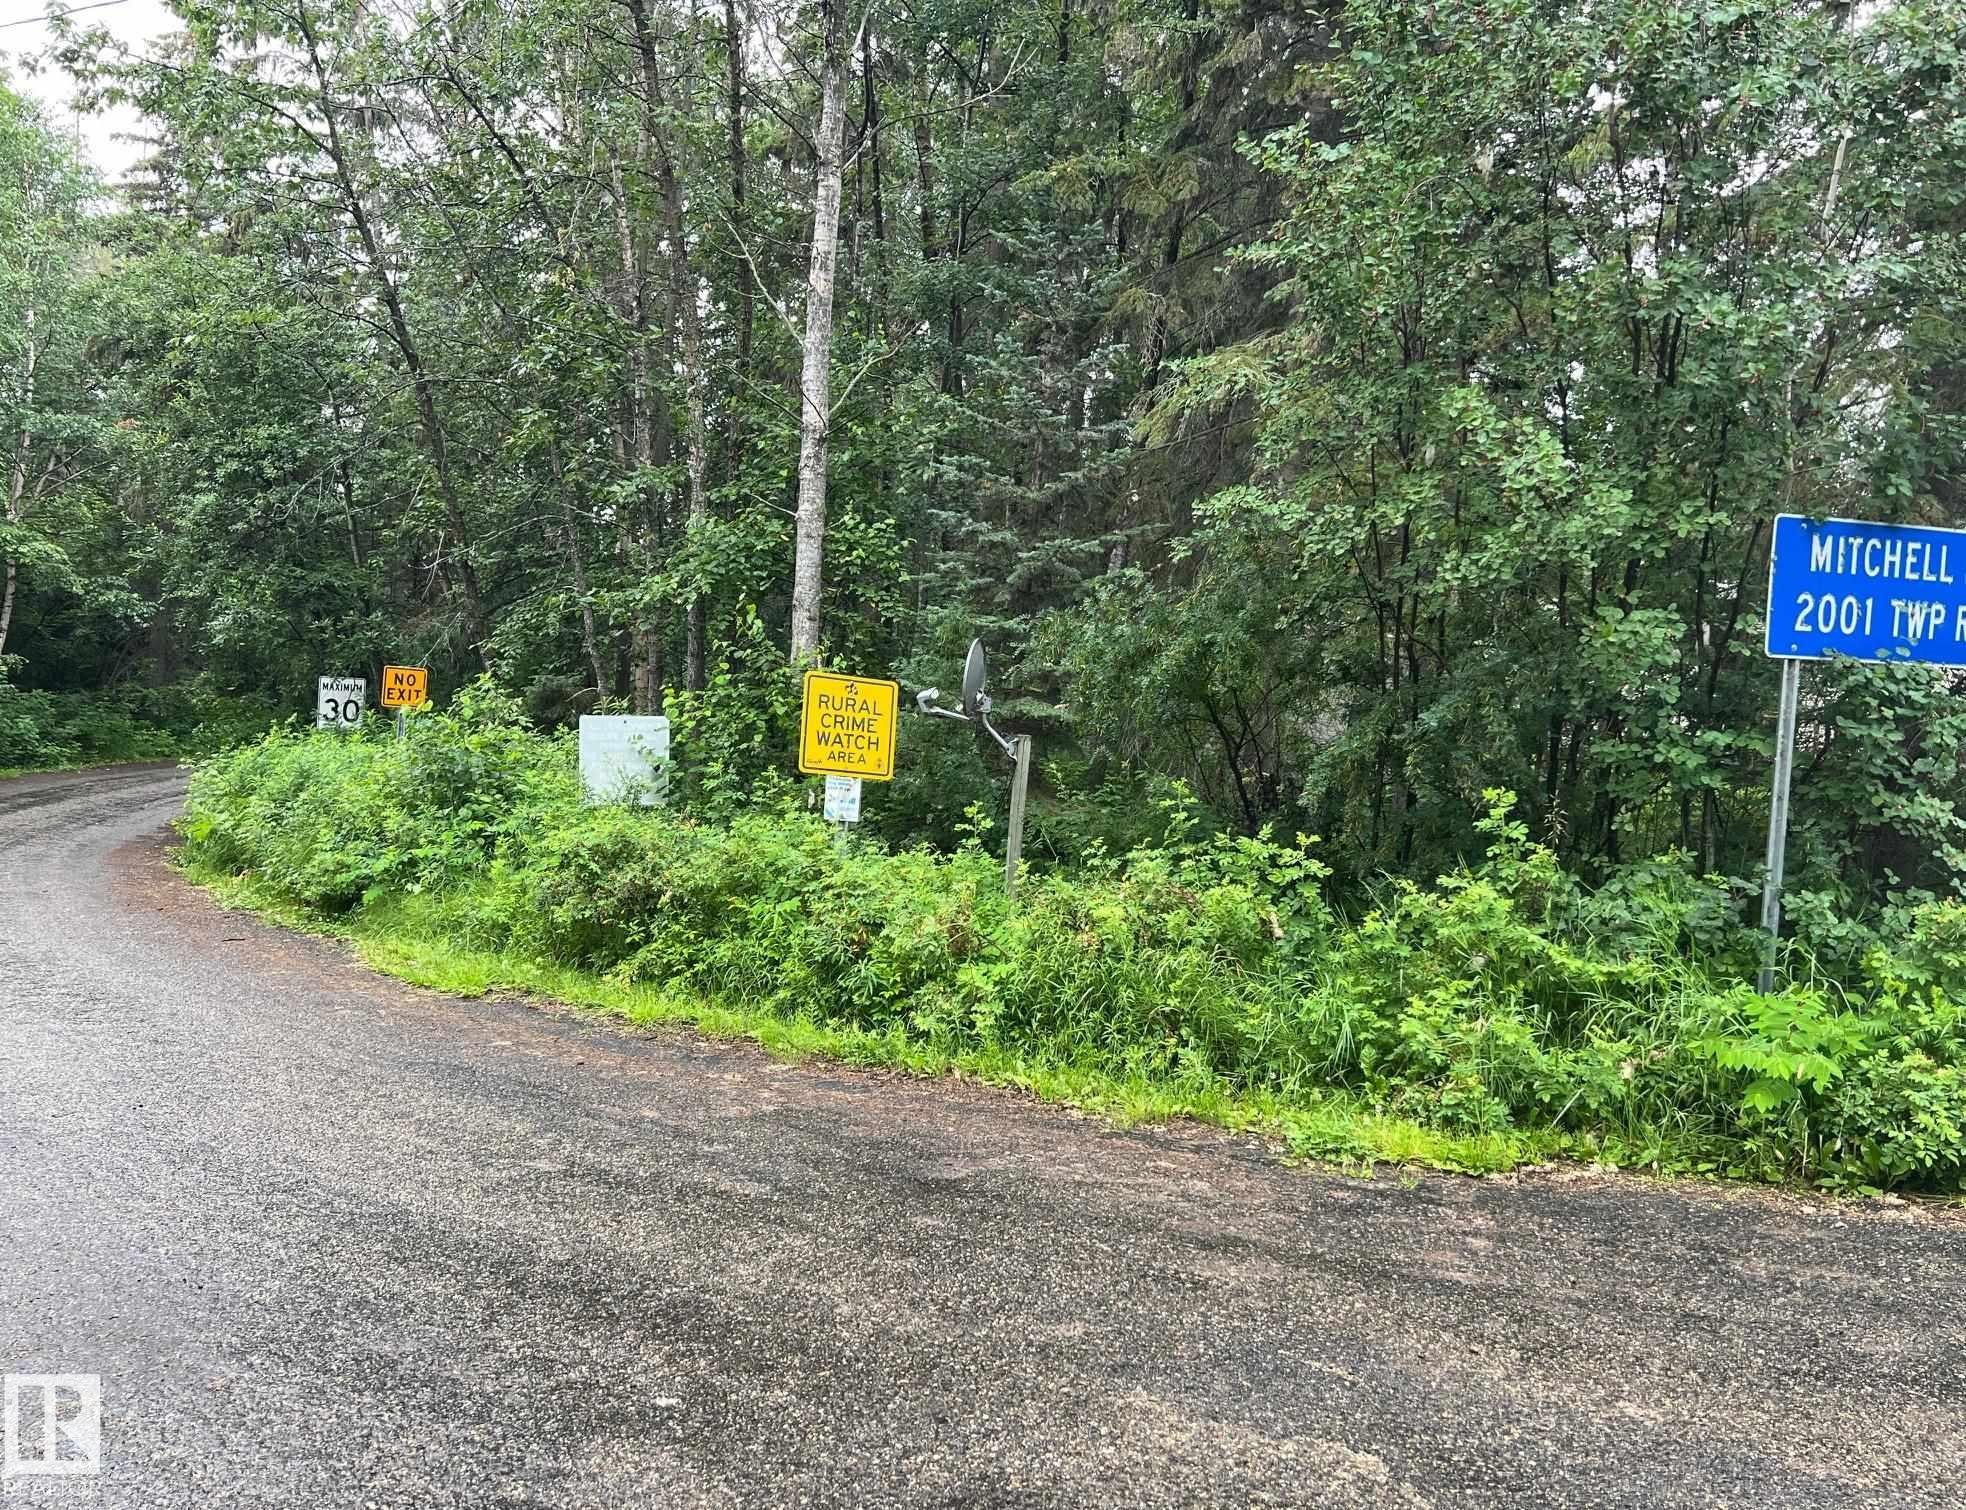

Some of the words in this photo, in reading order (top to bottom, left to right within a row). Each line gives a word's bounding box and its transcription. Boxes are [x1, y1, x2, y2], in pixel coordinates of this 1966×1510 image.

[1810, 532, 1953, 584] MITCHELL
[1794, 591, 1873, 636] 2001
[1891, 598, 1946, 640] TWP
[394, 673, 416, 686] NO
[386, 688, 422, 701] EXIT
[818, 694, 883, 716] RURAL
[322, 698, 359, 722] 30
[821, 713, 878, 733] CRIME
[816, 730, 879, 752] WATCH
[827, 750, 866, 764] AREA
